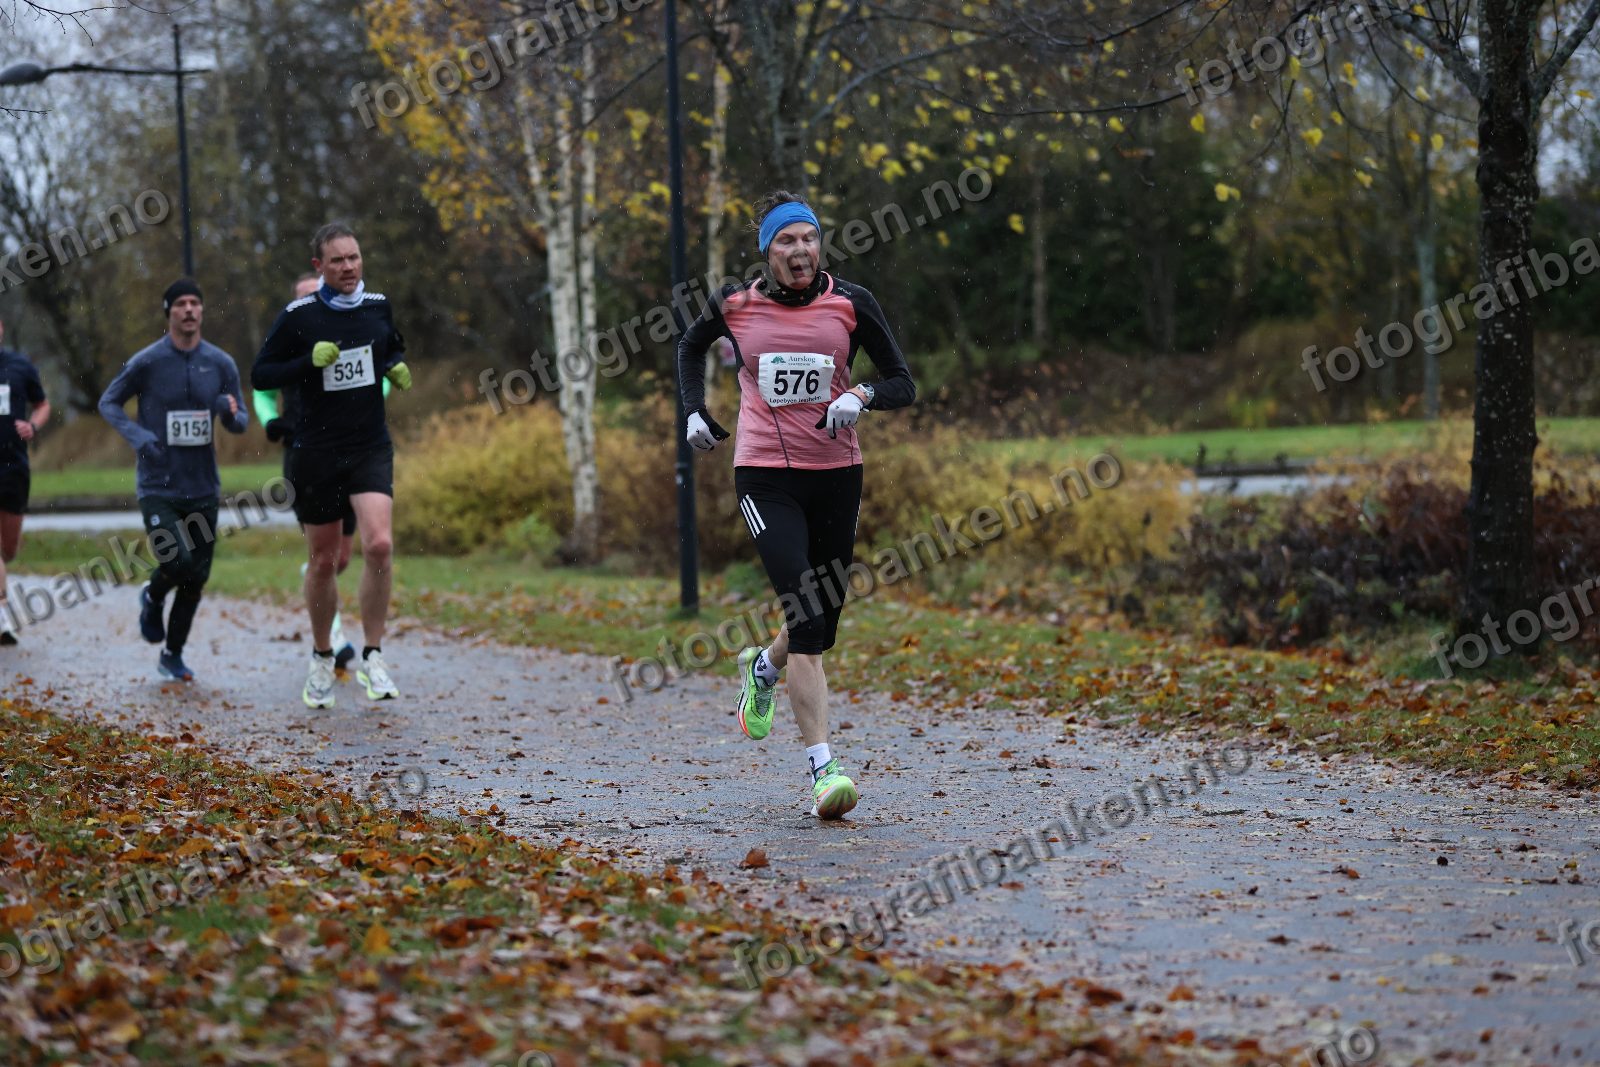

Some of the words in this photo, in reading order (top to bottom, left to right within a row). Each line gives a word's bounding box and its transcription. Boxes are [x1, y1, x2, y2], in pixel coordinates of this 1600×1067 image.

[789, 355, 816, 363] Aurskog
[334, 359, 364, 382] 534
[773, 369, 820, 396] 576
[172, 420, 209, 437] 9152
